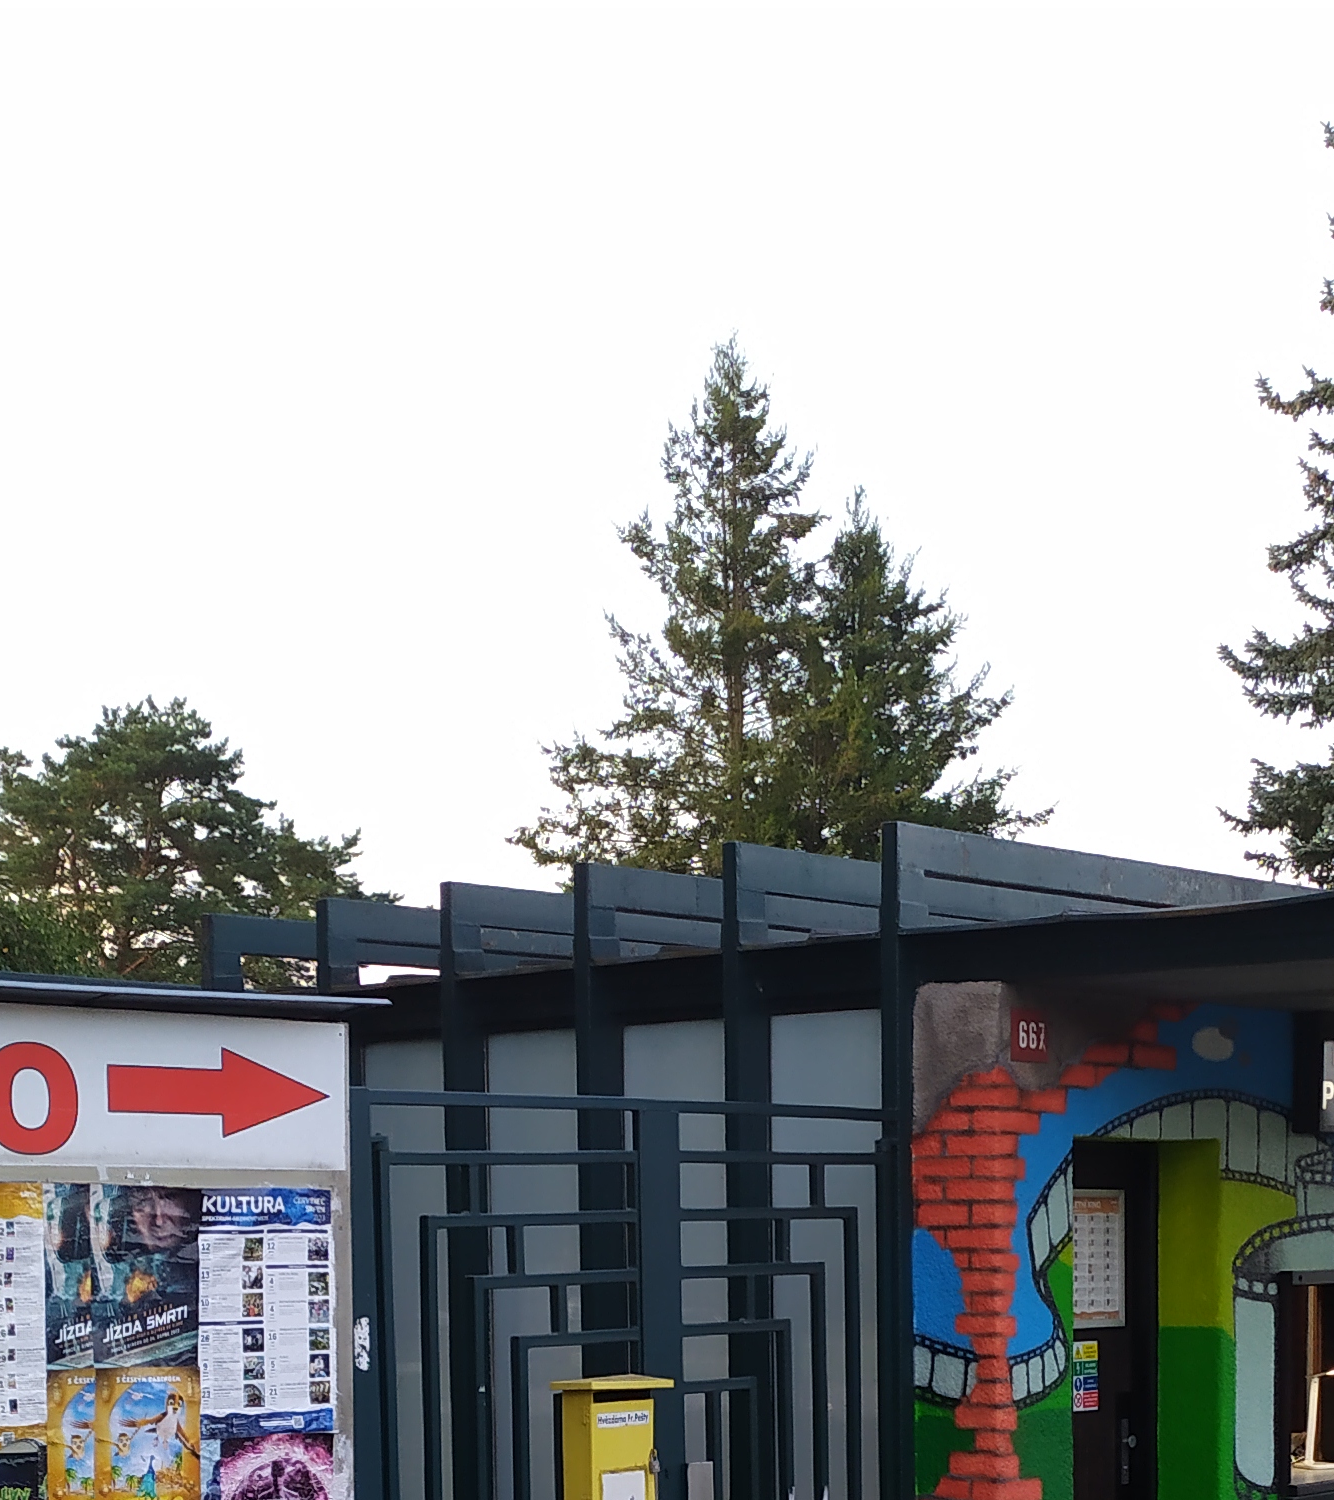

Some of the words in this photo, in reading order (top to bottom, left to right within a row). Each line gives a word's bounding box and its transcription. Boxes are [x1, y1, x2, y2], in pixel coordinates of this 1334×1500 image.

[202, 1195, 285, 1213] KULTURA
[54, 1320, 92, 1344] JÍZDA
[102, 1319, 143, 1344] JÍZDA
[146, 1304, 188, 1330] SMRTI
